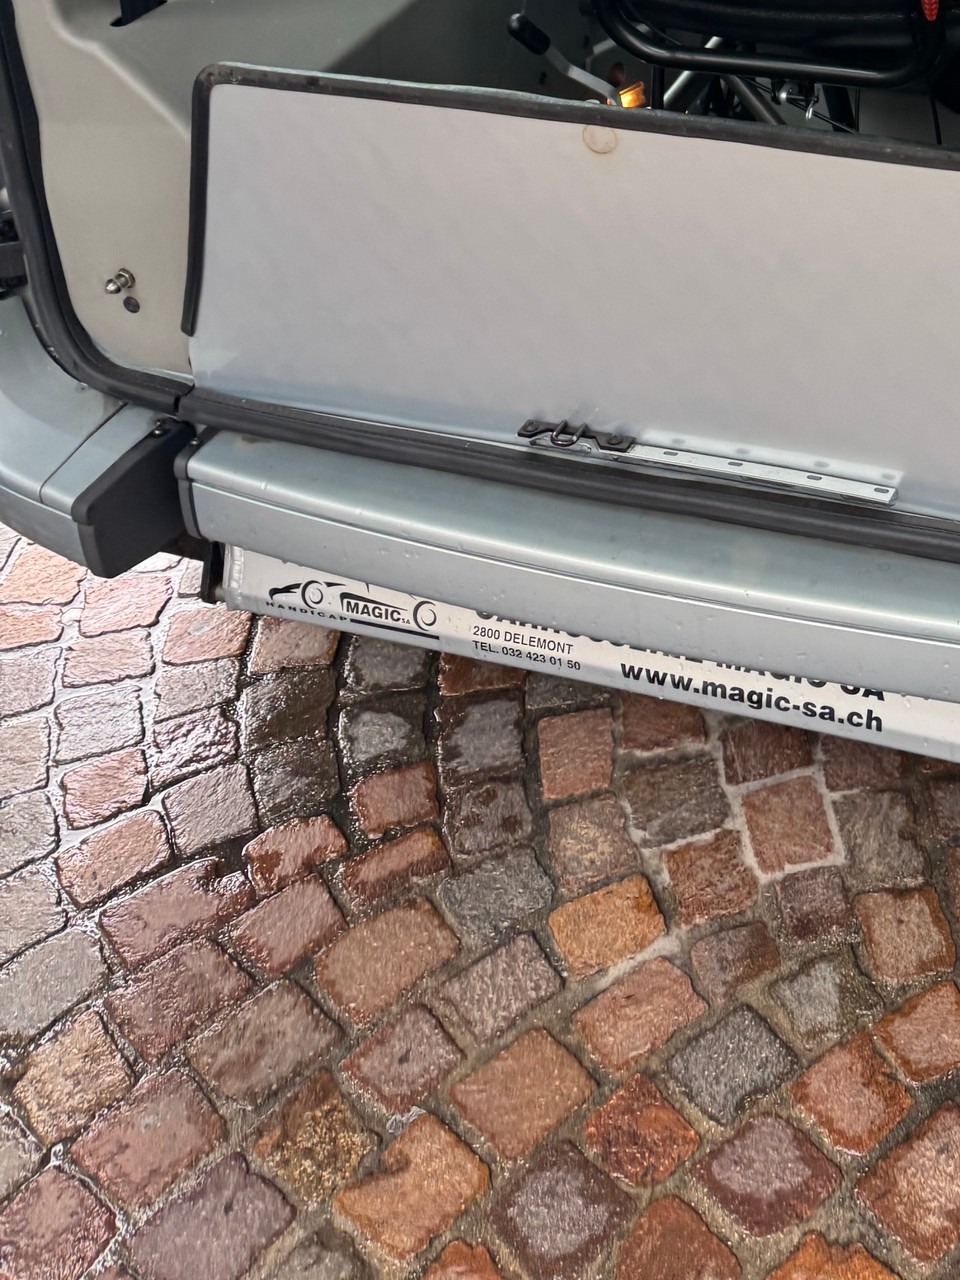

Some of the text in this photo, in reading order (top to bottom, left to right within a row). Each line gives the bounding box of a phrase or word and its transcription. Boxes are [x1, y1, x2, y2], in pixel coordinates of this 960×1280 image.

[265, 601, 348, 622] HANDICAP
[346, 599, 402, 621] MAGIC
[472, 625, 574, 655] 2800 DELEMONT
[472, 640, 581, 671] TEL. 032 423 01 50
[620, 662, 883, 733] www.magic-sa.ch
